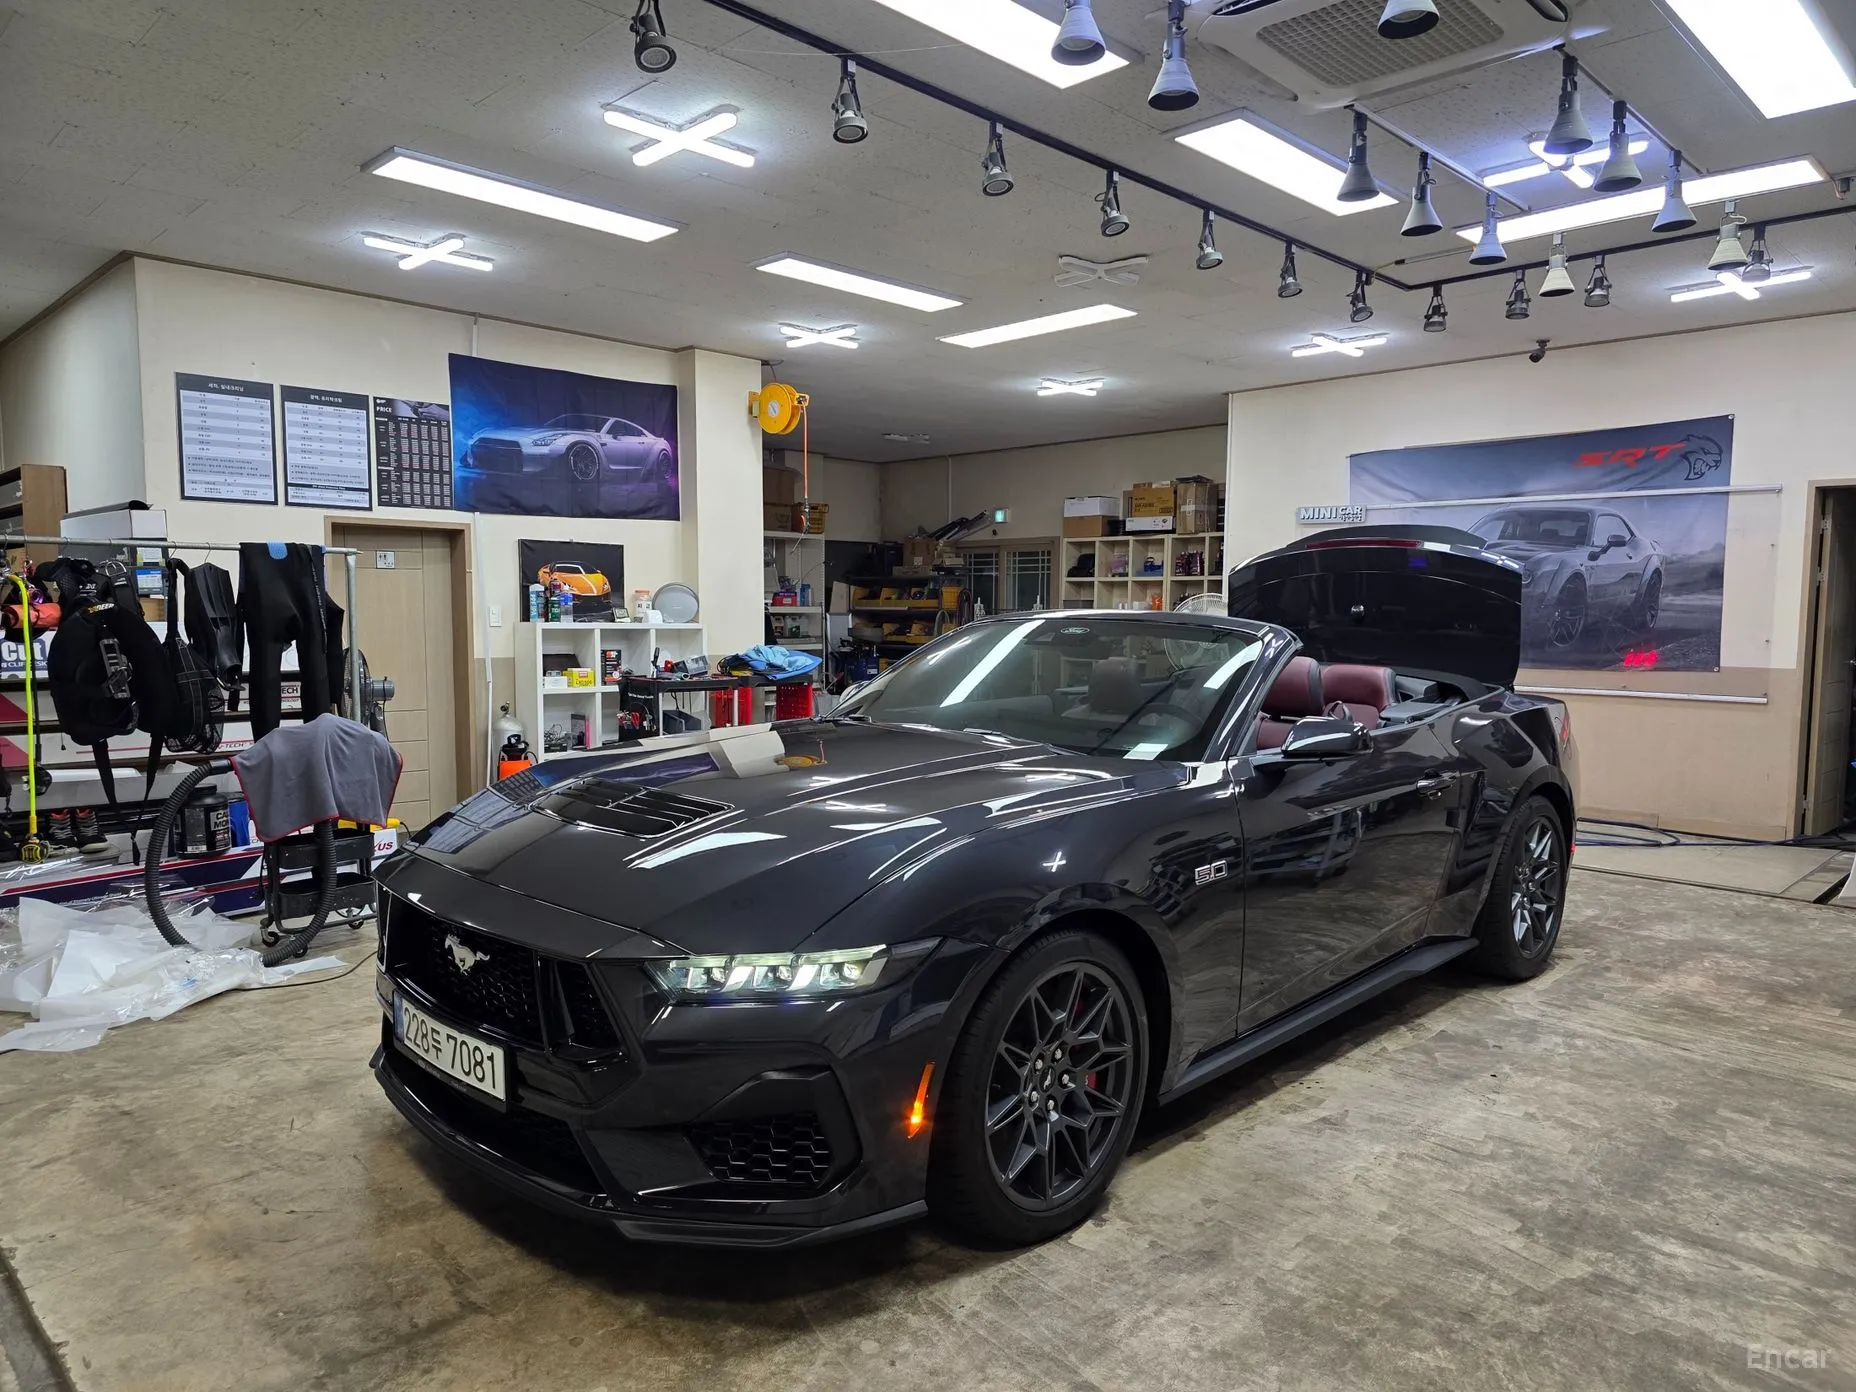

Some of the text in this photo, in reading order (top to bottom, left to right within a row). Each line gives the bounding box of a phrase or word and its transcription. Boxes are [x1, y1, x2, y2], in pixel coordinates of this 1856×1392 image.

[1573, 442, 1687, 469] SRT
[1300, 507, 1338, 520] MINI
[1339, 506, 1363, 516] CAR
[281, 687, 298, 695] ECH
[1194, 860, 1228, 886] 5.0
